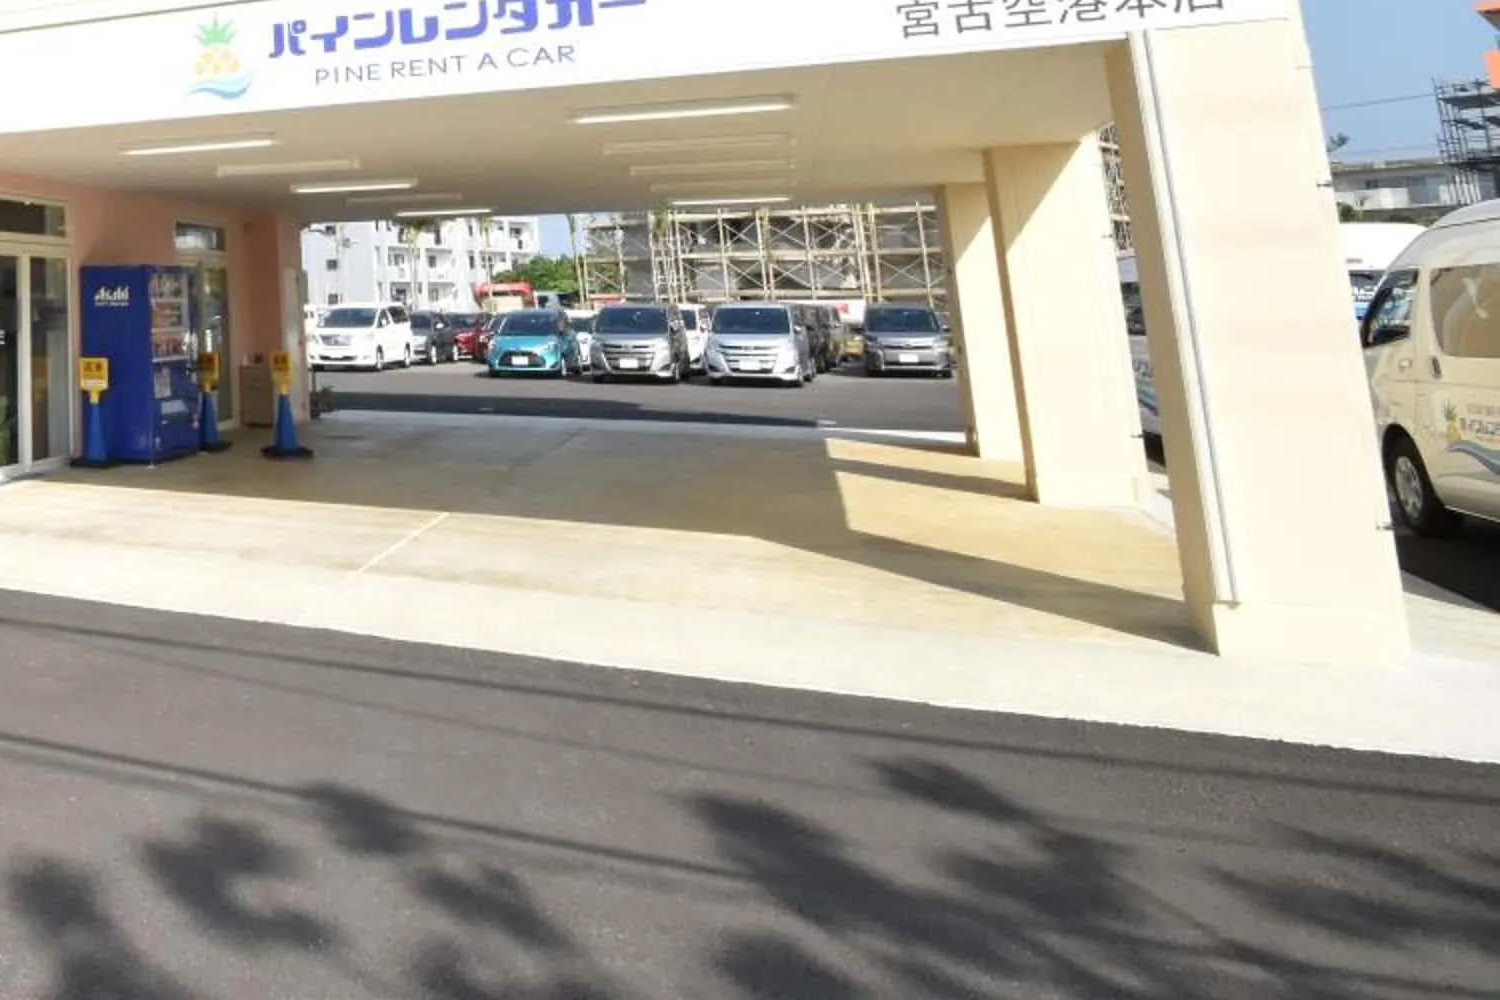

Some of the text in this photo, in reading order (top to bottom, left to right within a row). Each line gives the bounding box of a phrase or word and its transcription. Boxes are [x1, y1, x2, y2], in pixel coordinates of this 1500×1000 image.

[315, 44, 577, 85] PINE RENT A CAR
